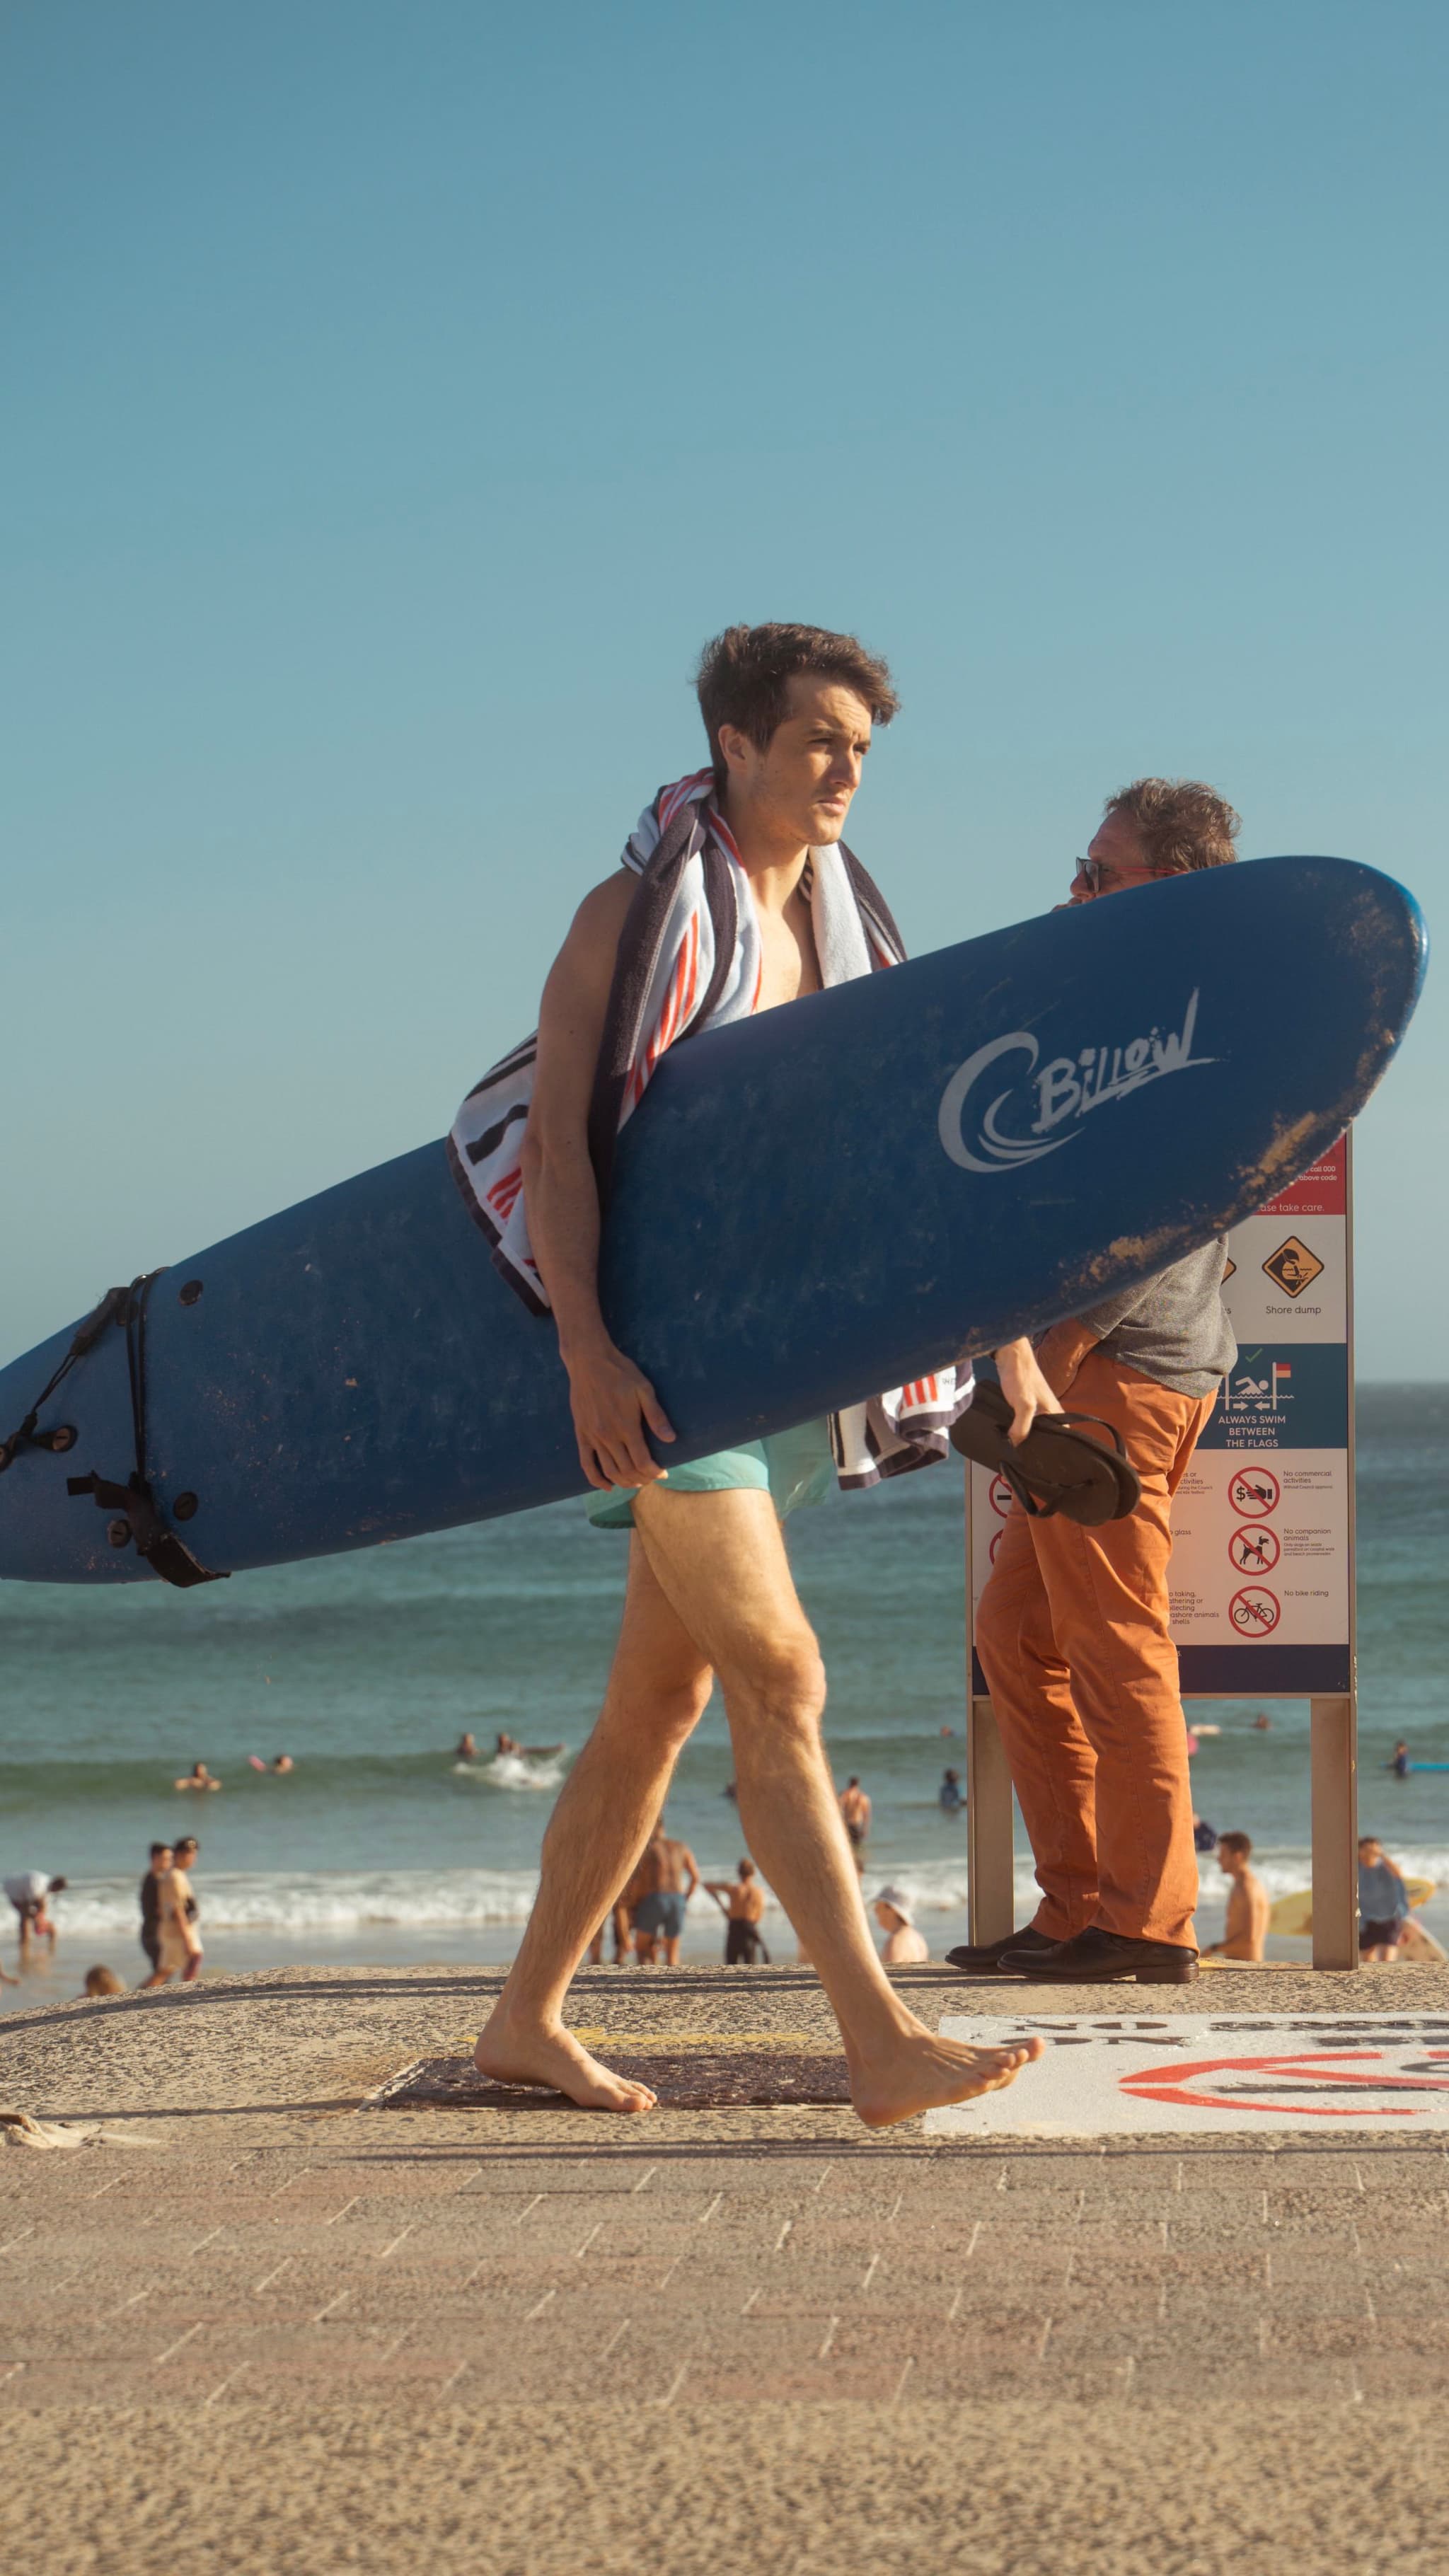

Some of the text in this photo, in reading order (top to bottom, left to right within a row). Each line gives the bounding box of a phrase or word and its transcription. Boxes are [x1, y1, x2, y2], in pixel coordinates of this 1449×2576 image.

[1279, 1203, 1300, 1212] take
[1266, 1305, 1322, 1316] Shore dump
[1218, 1416, 1286, 1424] ALWAYS SWIM
[1229, 1428, 1276, 1436] BETWEEN
[1226, 1439, 1279, 1448] THE FLAGS
[1005, 2021, 1169, 2032] NO
